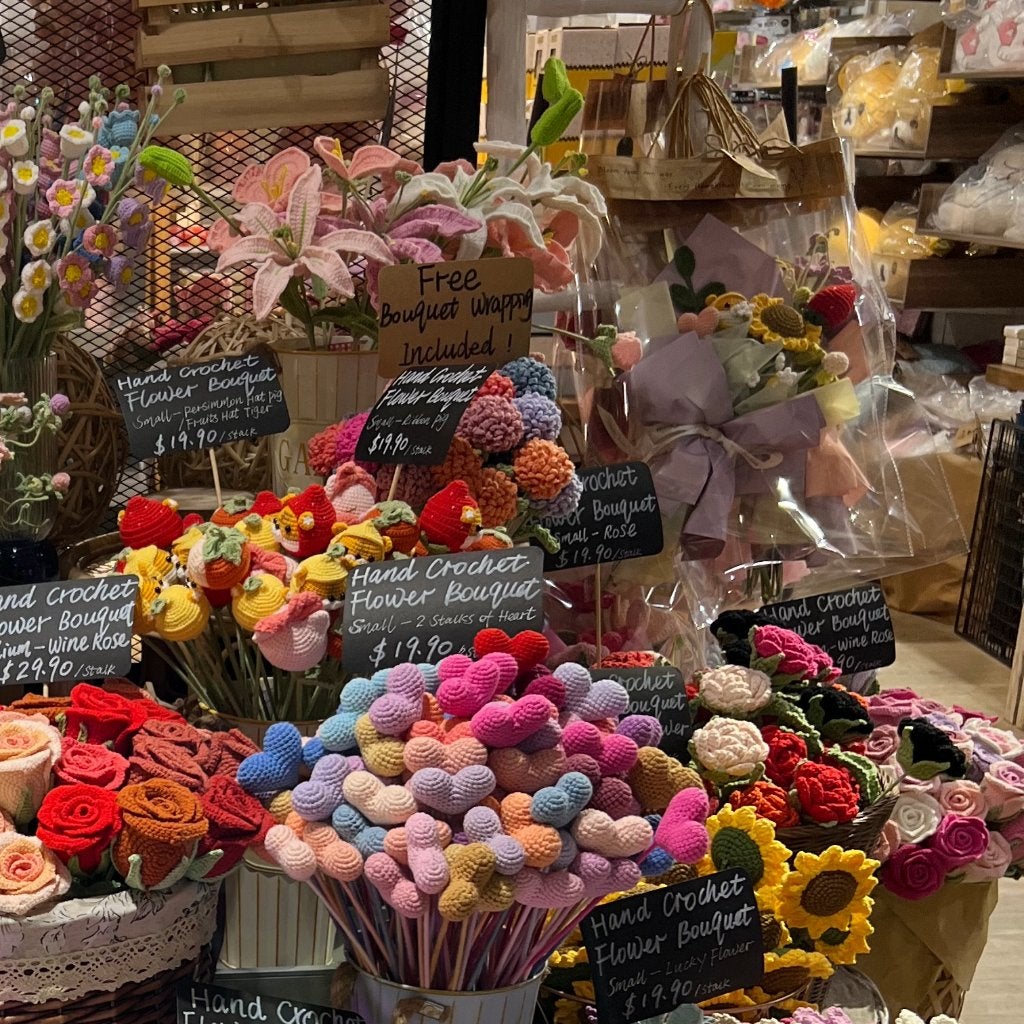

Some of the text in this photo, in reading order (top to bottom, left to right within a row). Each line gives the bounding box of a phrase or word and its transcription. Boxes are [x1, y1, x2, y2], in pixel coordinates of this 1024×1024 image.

[418, 264, 481, 295] Free
[380, 297, 459, 334] Bouquet
[399, 326, 496, 366] Included
[118, 370, 171, 390] Hand
[124, 367, 276, 412] Flower Bouquet
[392, 367, 437, 386] Hand
[244, 405, 273, 418] Tiger
[377, 387, 478, 412] Flower Bouquet
[582, 466, 638, 492] rochet
[592, 494, 655, 524] Bouquet
[604, 524, 637, 539] Rose
[351, 555, 530, 587] Hand Crochet
[47, 579, 139, 606] Crochet
[350, 578, 541, 616] Flower Bouquet
[817, 586, 881, 611] Crochet
[59, 601, 134, 637] Bouquet
[348, 615, 396, 635] Small
[416, 616, 425, 627] 2
[479, 610, 493, 627] of
[498, 607, 536, 622] Heart
[832, 606, 890, 632] Bouquet
[49, 637, 89, 655] Wine
[92, 632, 129, 650] Rose
[871, 631, 894, 644] Rose
[608, 669, 675, 692] ochet
[623, 693, 686, 720] ouquet
[591, 874, 746, 938] Hand Crochet
[594, 904, 755, 976] Flower Bouquet
[666, 953, 706, 975] Lucky
[711, 941, 754, 966] Flower
[191, 988, 267, 1021] Hand
